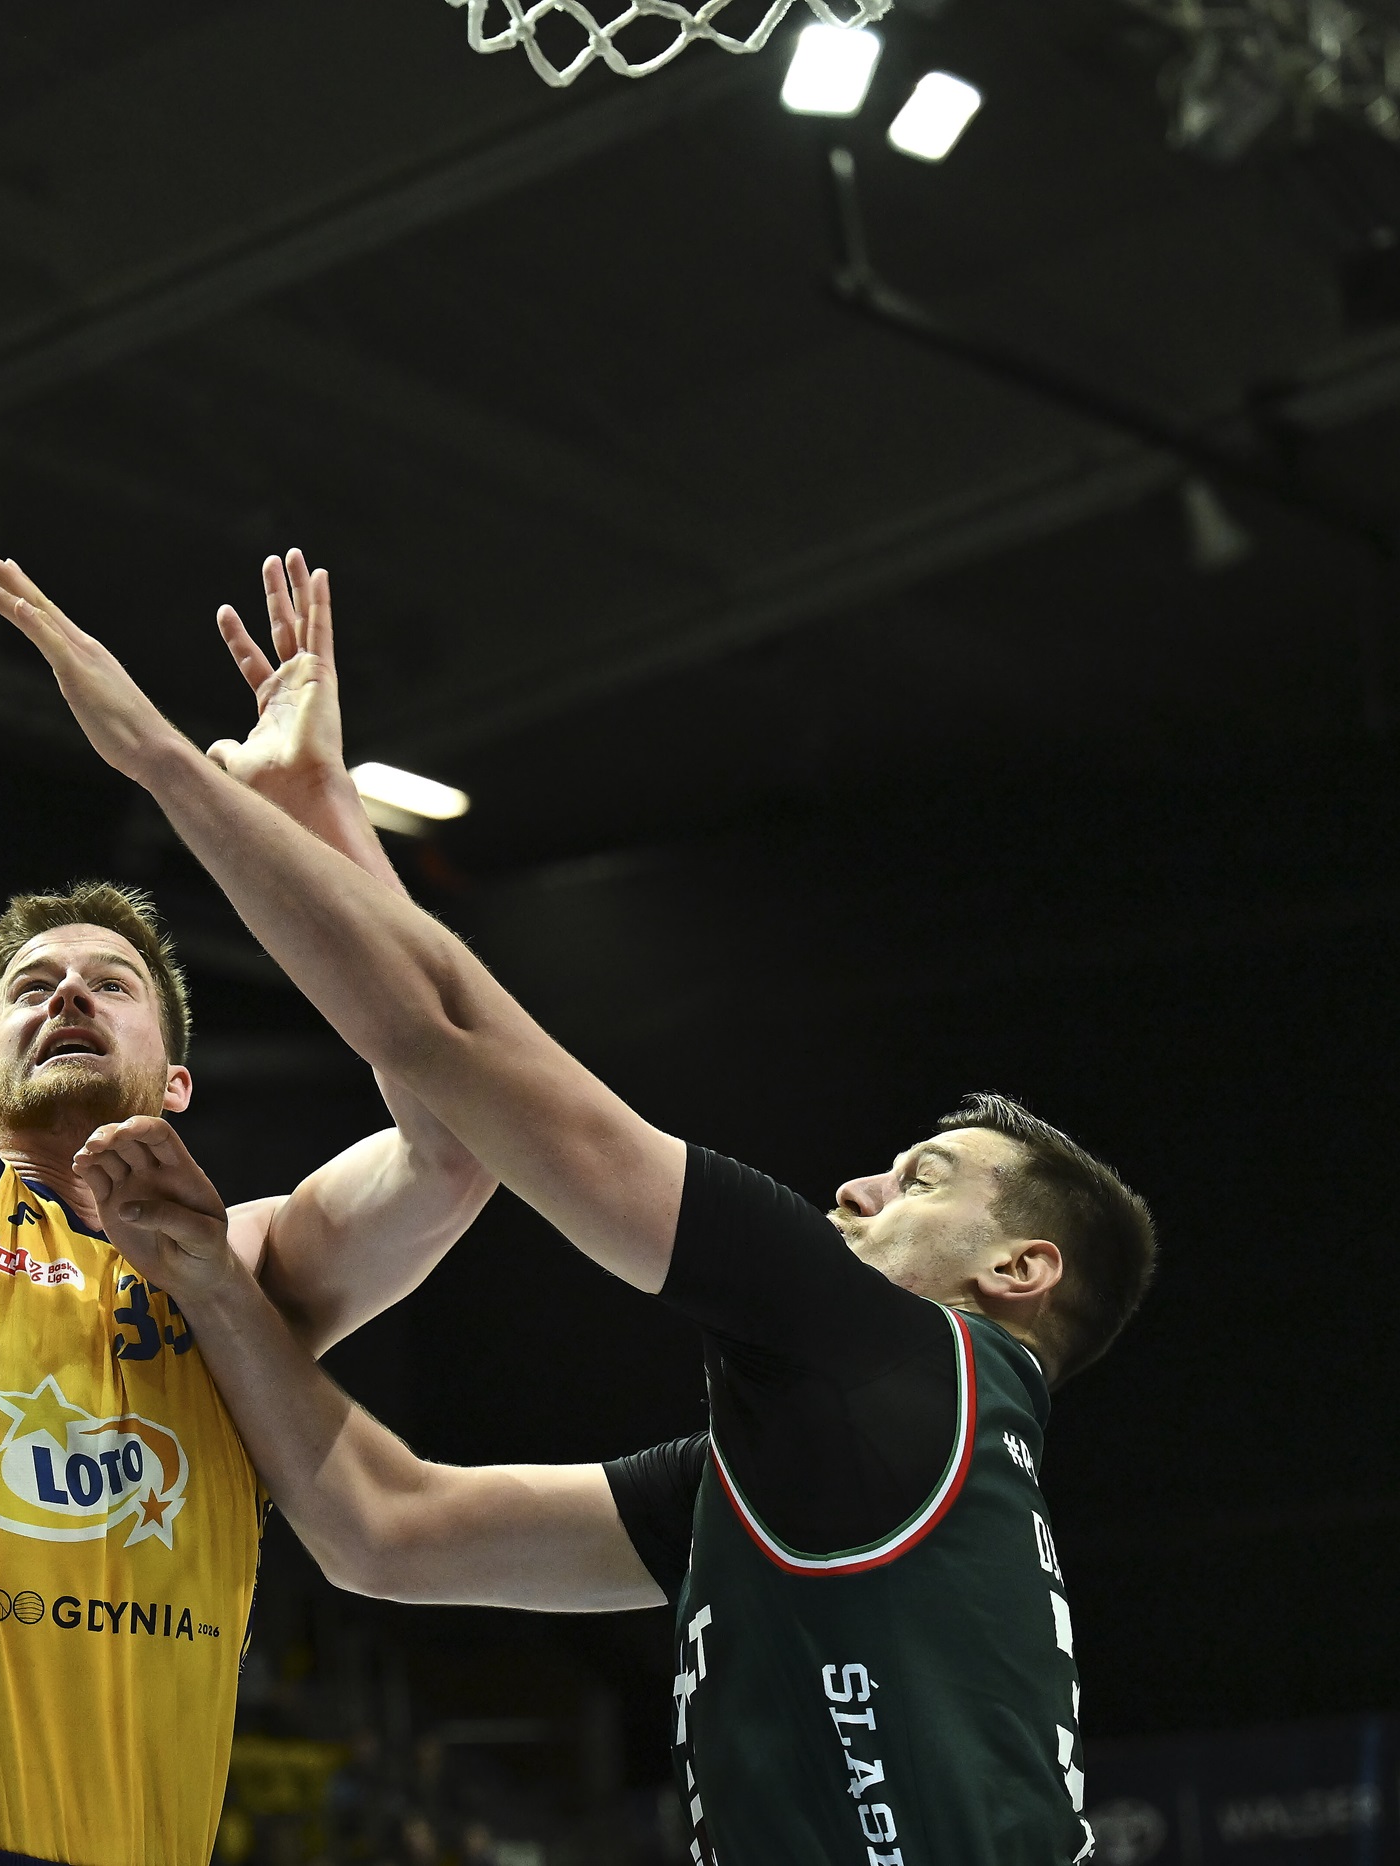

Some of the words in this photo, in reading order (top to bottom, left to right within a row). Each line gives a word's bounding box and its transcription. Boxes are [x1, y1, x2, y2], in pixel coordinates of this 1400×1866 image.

[47, 1272, 70, 1284] Liga
[31, 1440, 144, 1508] LOTO
[51, 1595, 195, 1642] GDYNIA
[197, 1622, 221, 1638] 2026
